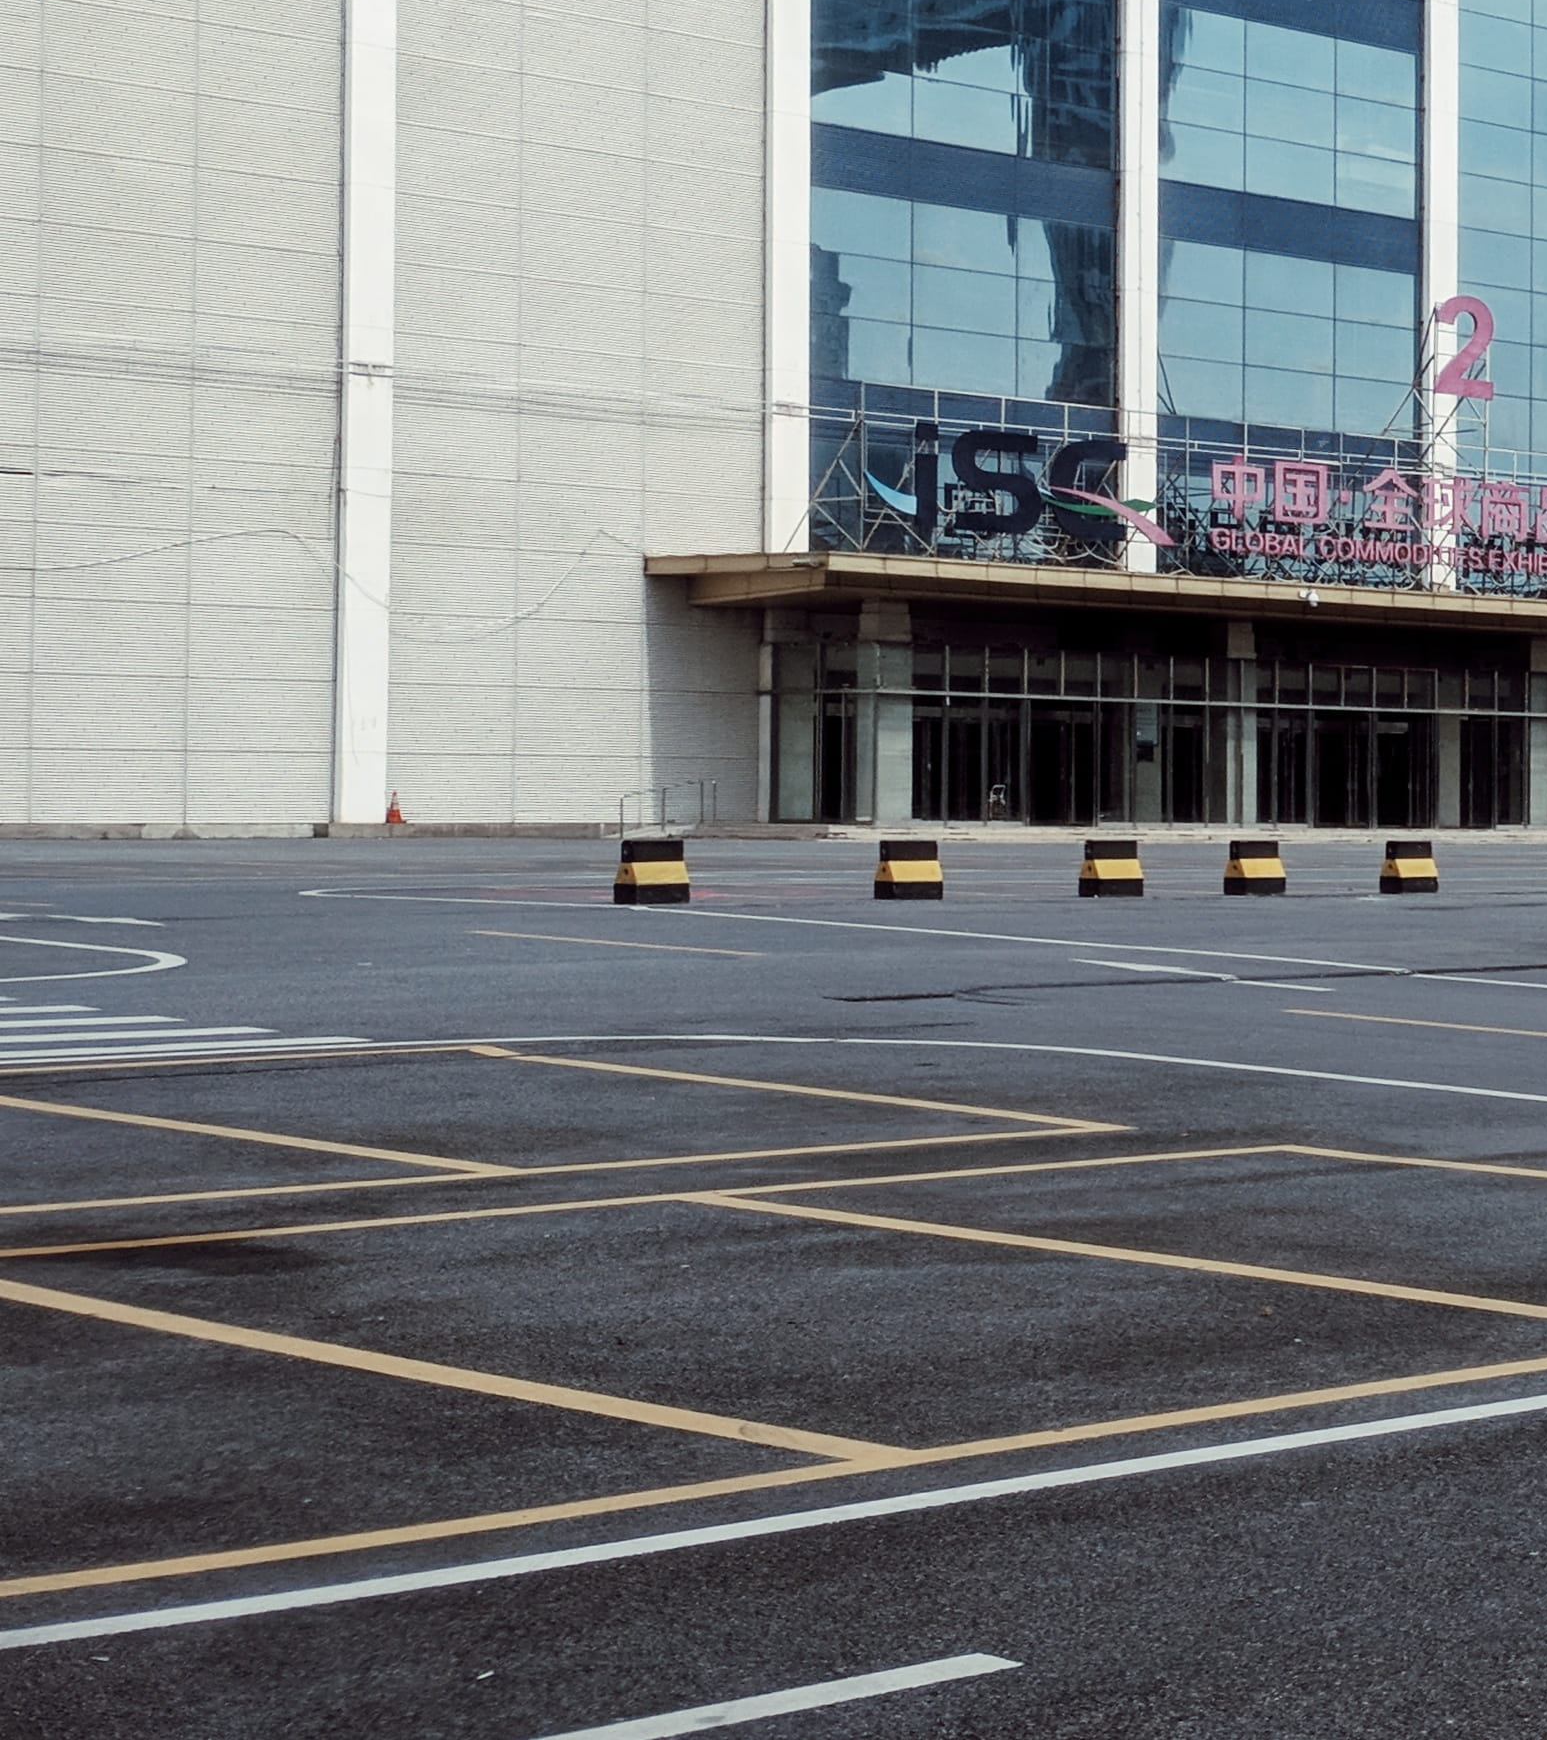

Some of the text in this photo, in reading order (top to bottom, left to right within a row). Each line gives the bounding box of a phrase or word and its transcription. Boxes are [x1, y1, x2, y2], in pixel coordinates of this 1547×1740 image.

[1434, 296, 1495, 401] 2
[1212, 527, 1308, 558] GLOBAL
[1319, 536, 1483, 569] COMMODITIES
